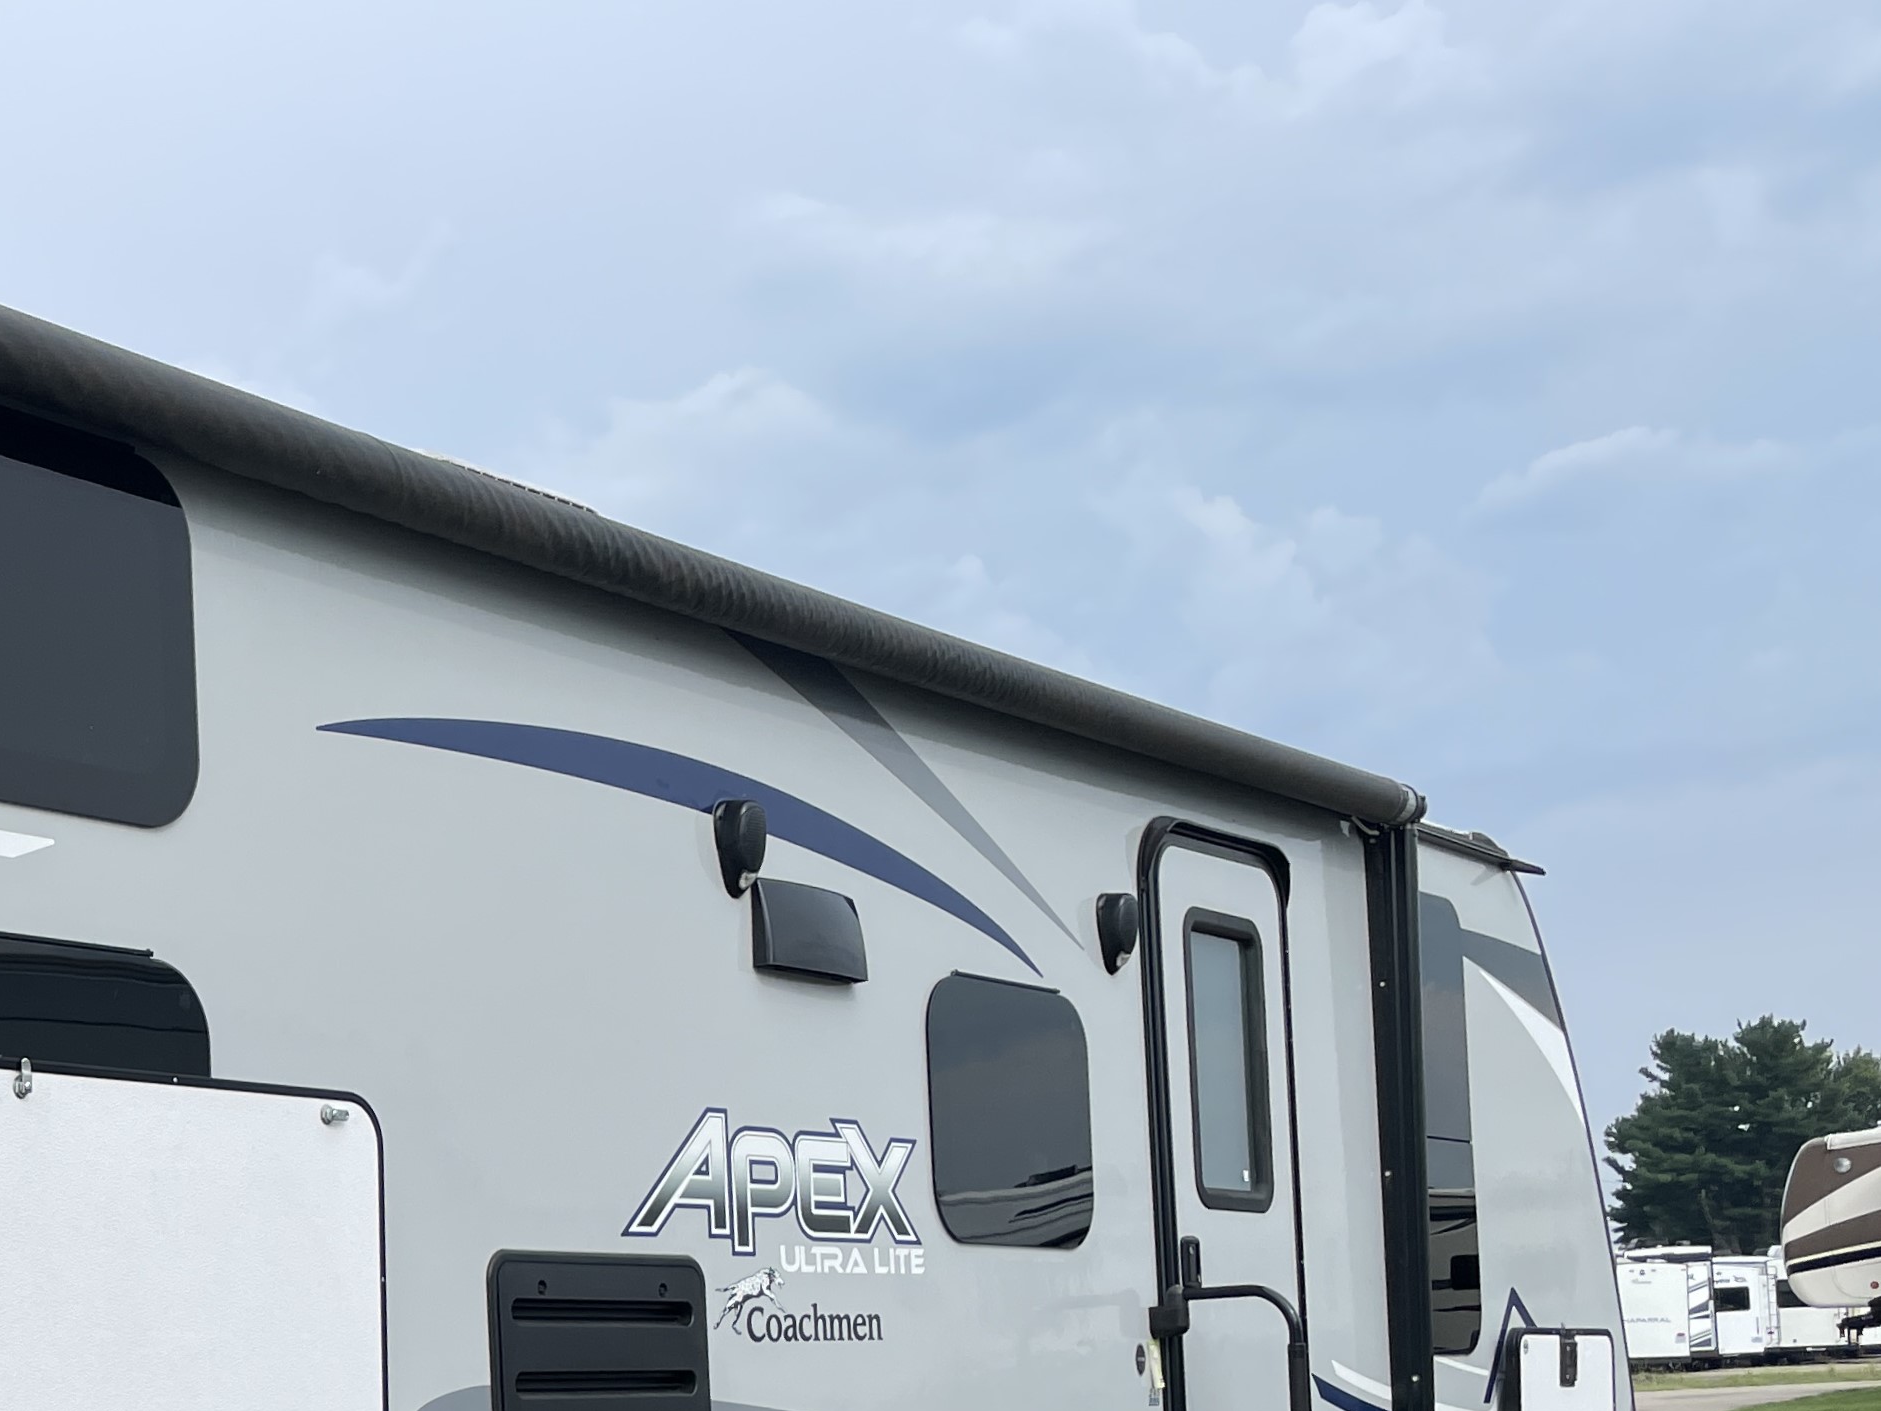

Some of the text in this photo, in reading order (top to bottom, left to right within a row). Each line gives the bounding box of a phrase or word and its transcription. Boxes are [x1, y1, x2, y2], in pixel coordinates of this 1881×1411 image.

[621, 1107, 922, 1256] APEX
[779, 1245, 926, 1275] ULTRA LITE
[746, 1303, 884, 1343] Coachmen
